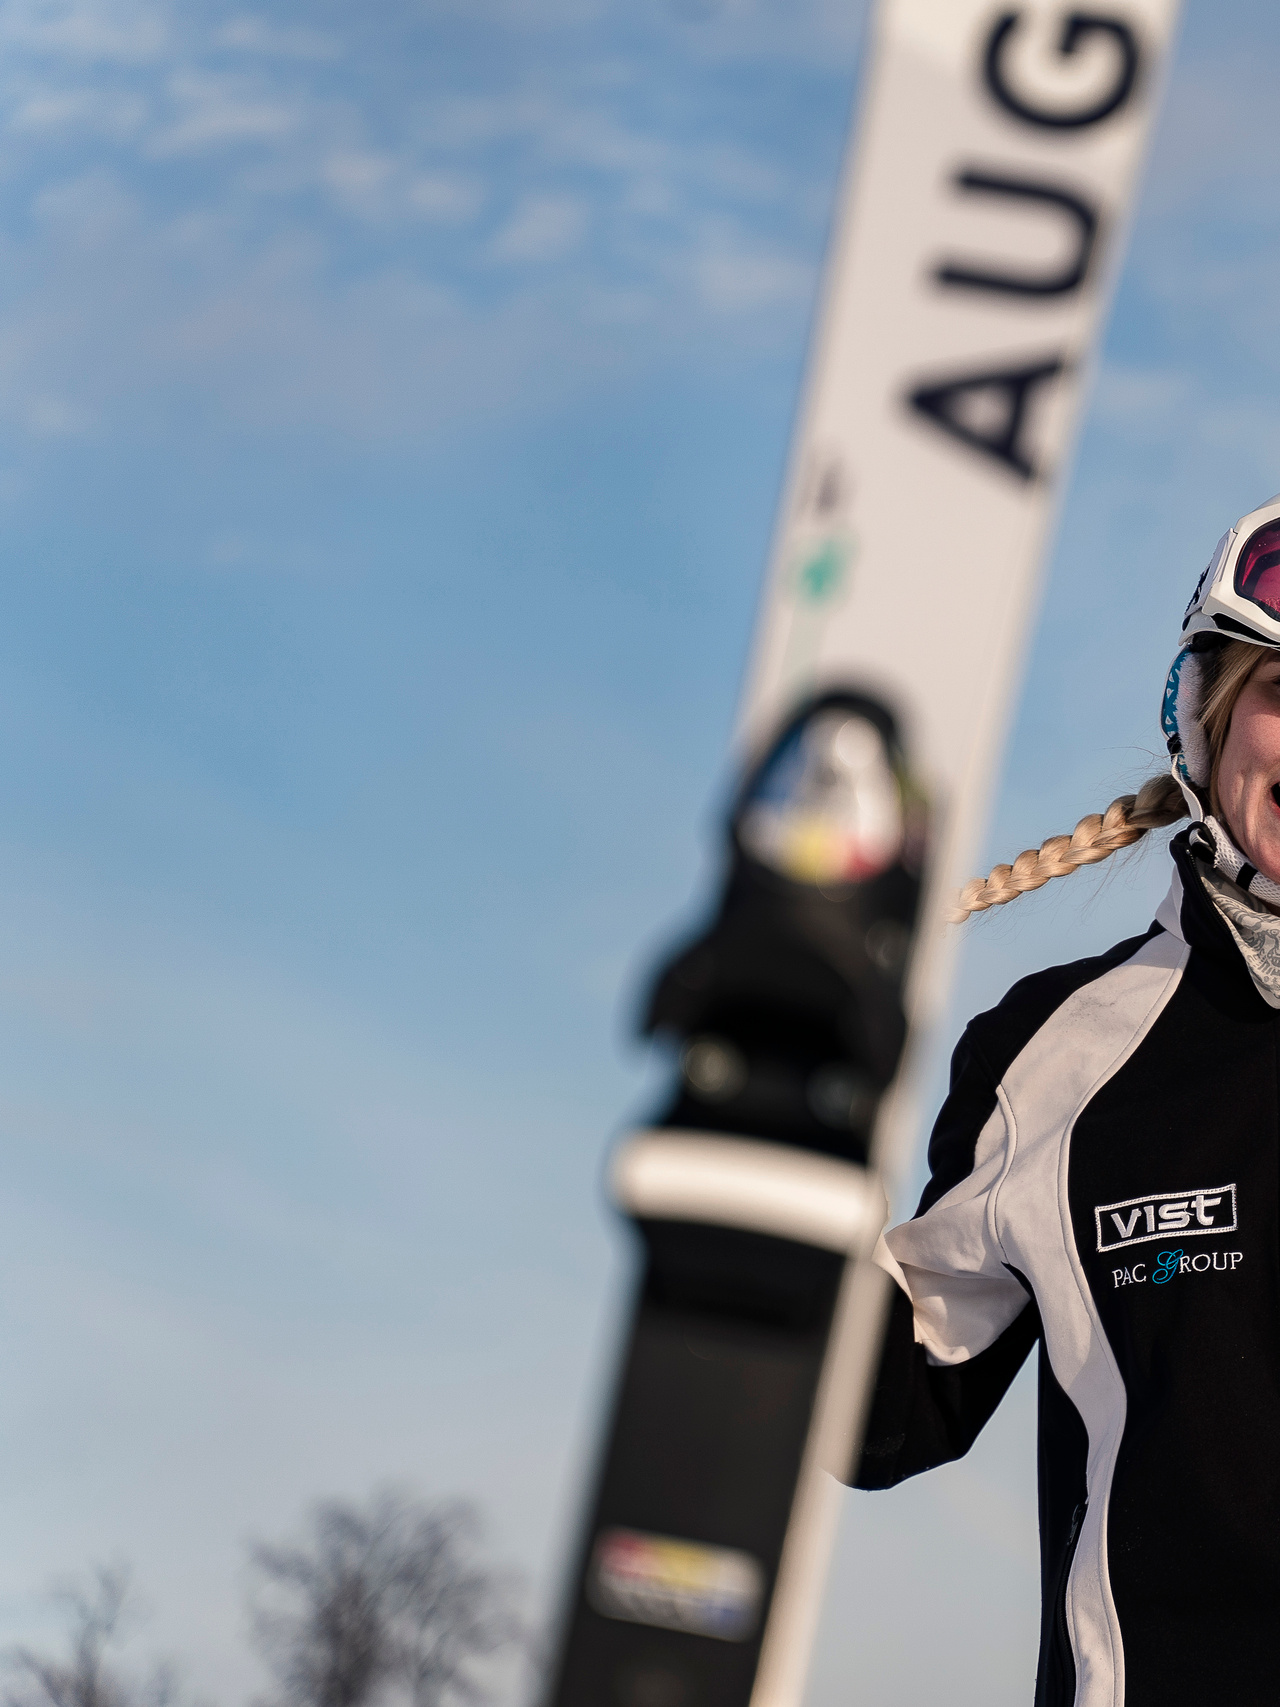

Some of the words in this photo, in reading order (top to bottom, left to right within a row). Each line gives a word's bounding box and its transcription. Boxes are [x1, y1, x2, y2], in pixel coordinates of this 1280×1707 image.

[901, 3, 1148, 491] AUG
[1112, 1263, 1147, 1288] PAC
[1152, 1248, 1244, 1285] GROUP
